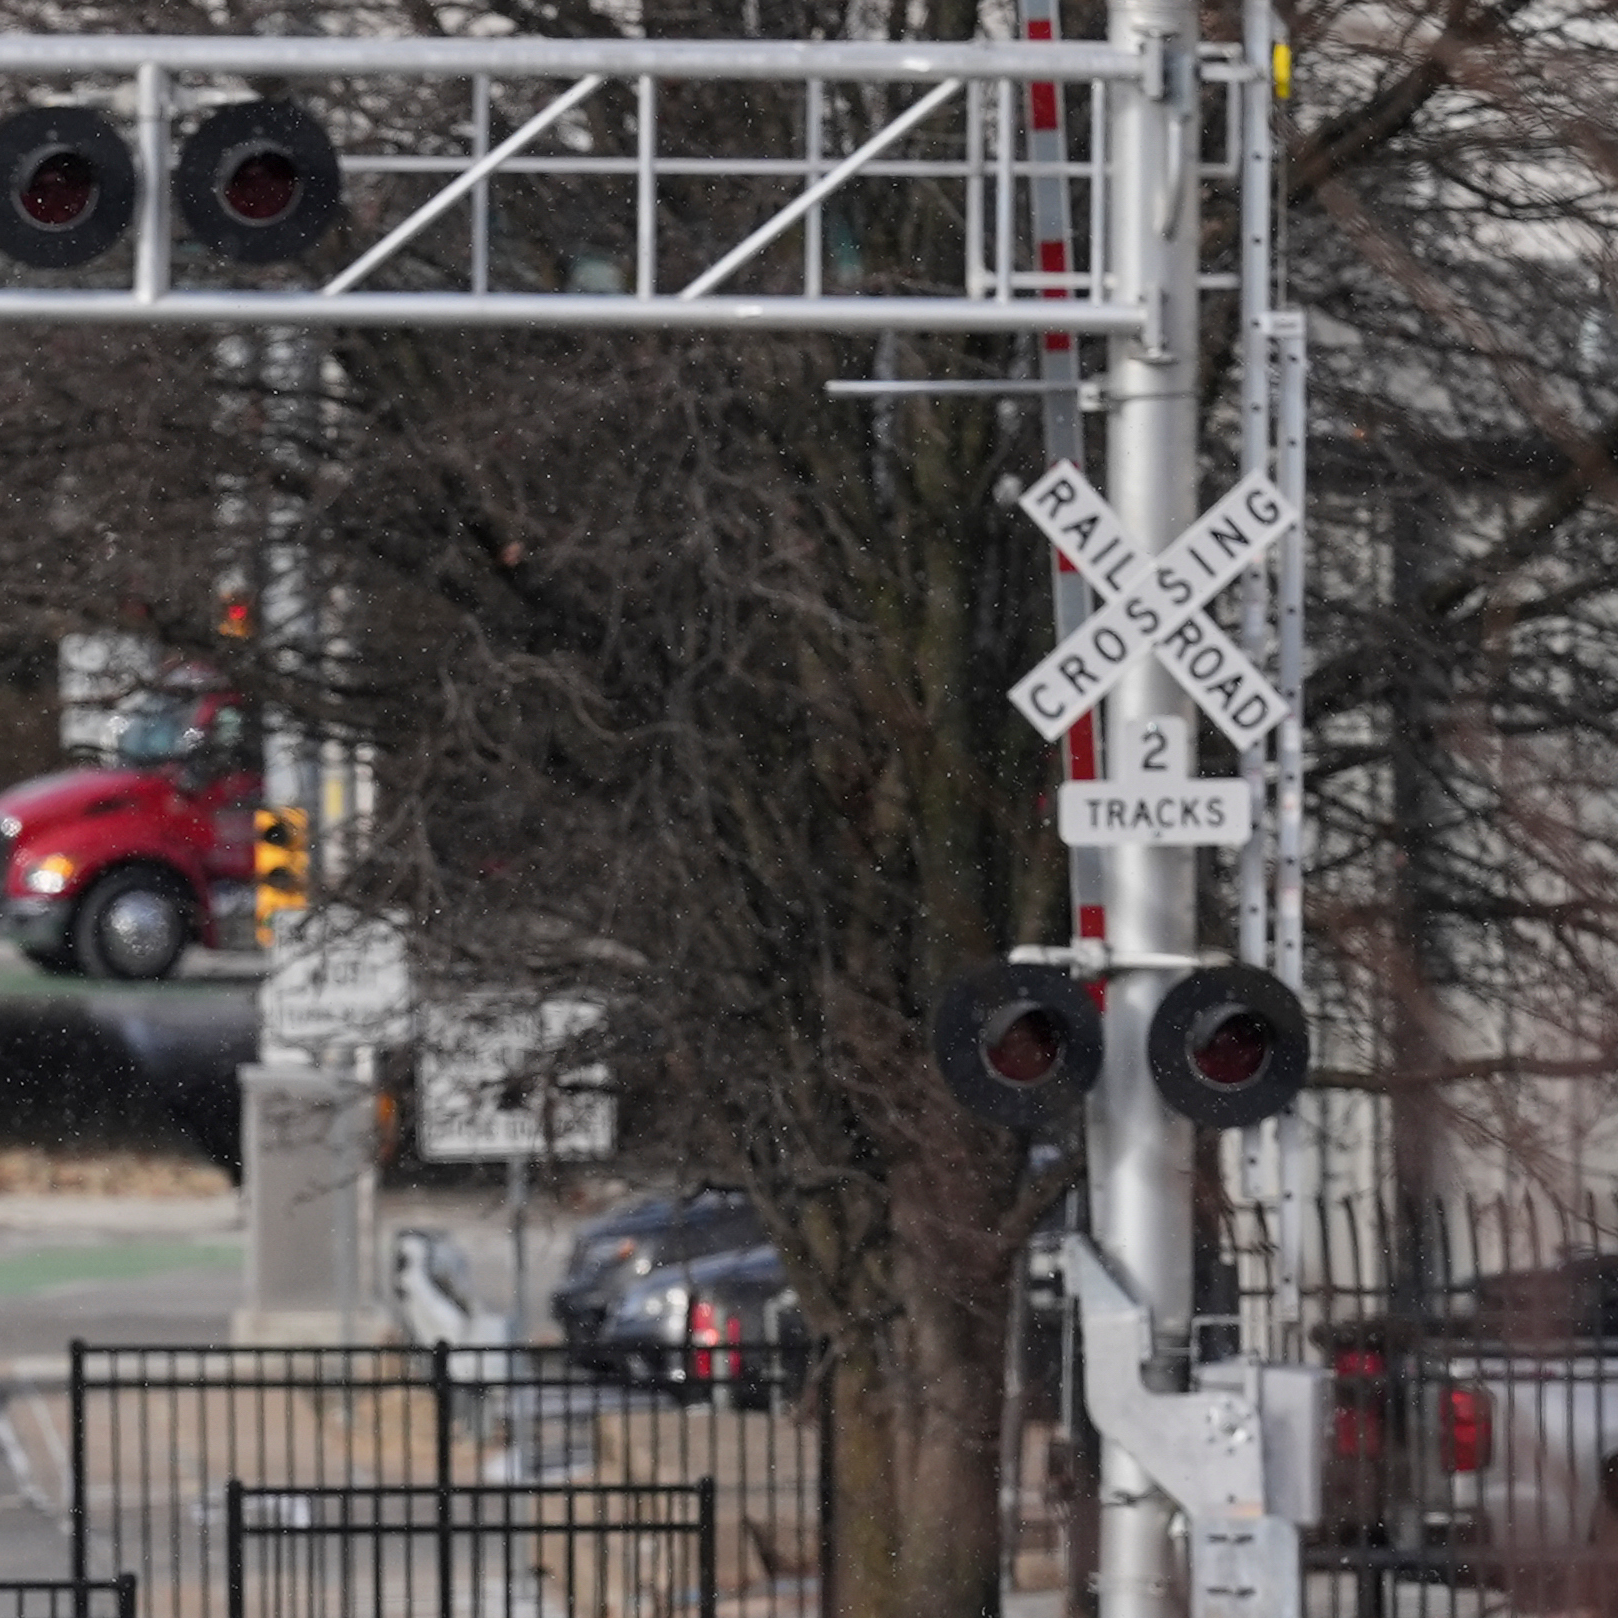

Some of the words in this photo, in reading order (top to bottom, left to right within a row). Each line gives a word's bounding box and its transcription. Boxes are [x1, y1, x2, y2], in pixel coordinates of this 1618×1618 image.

[1030, 490, 1279, 720] CROSSING
[1039, 479, 1135, 592] RAIL
[1165, 620, 1269, 729] ROAD
[1086, 799, 1226, 829] TRACKS
[1143, 732, 1168, 771] 2
